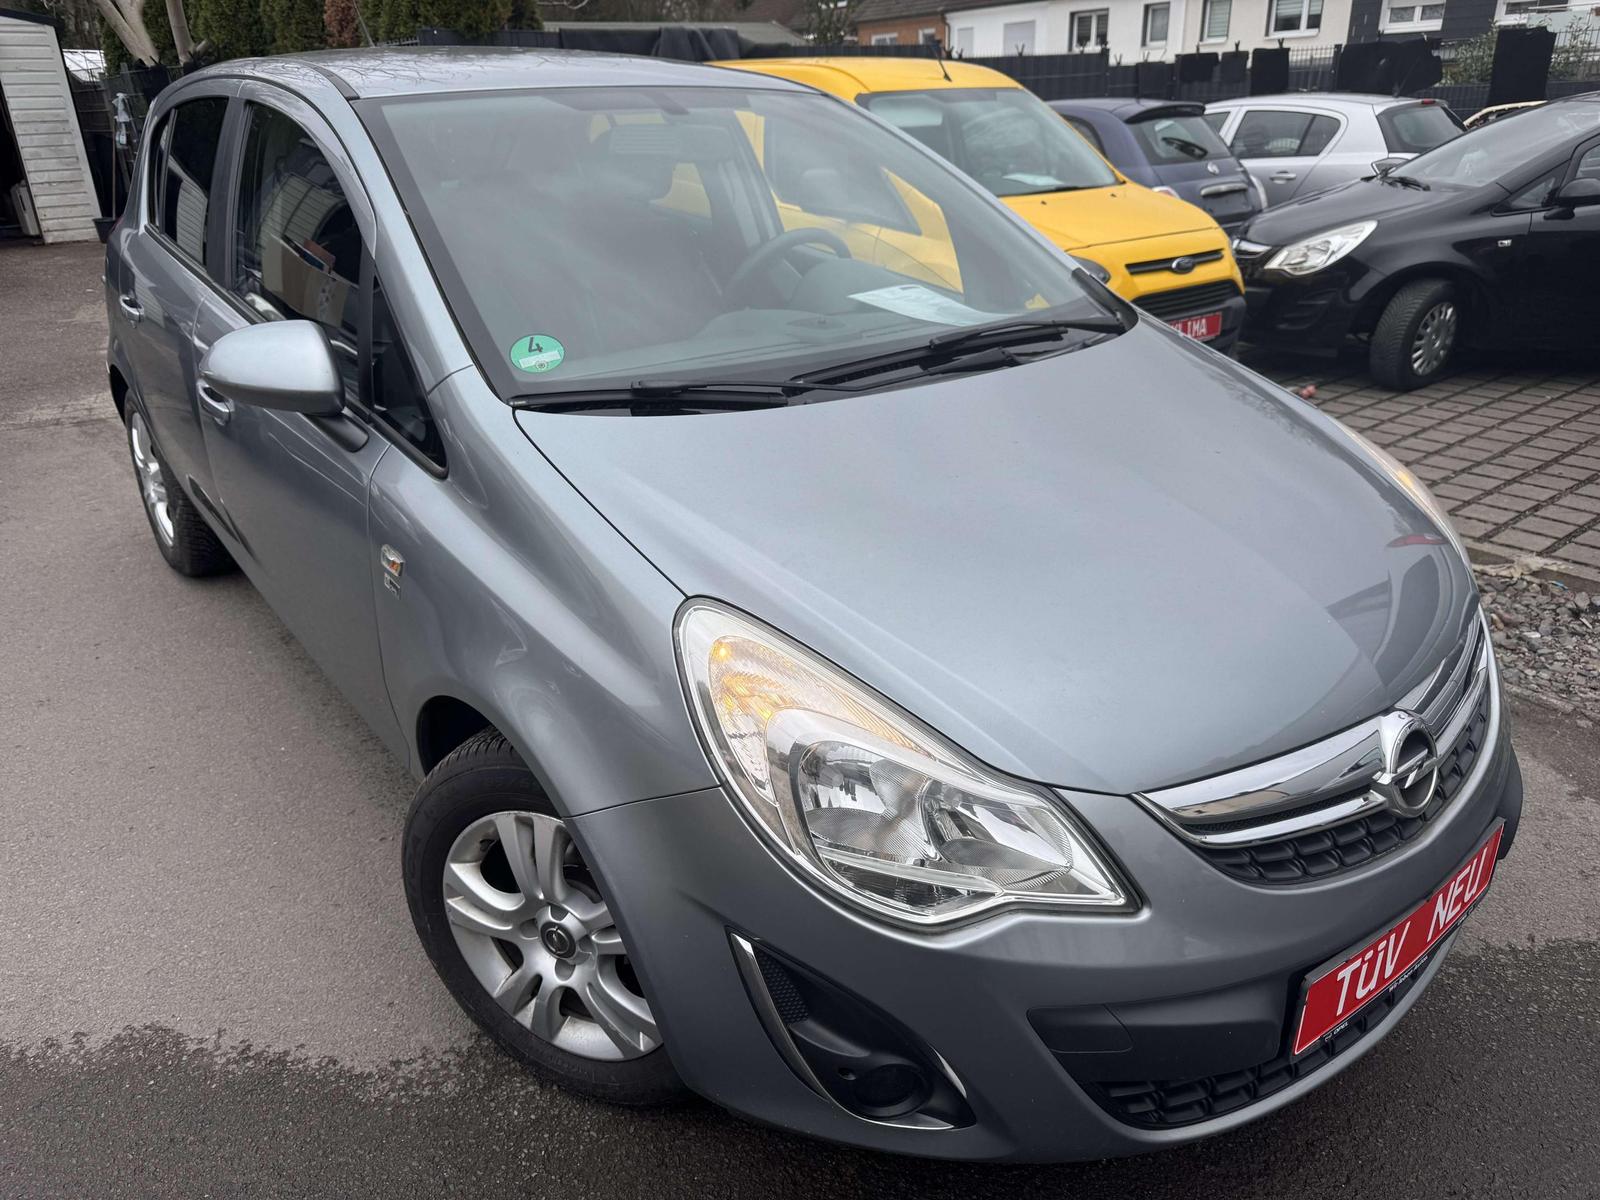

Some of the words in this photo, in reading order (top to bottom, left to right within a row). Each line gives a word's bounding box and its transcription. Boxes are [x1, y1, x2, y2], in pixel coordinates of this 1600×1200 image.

[1171, 318, 1206, 336] IMA
[528, 336, 543, 353] 4
[1336, 920, 1411, 1017] TÜV
[1427, 847, 1488, 943] NEU
